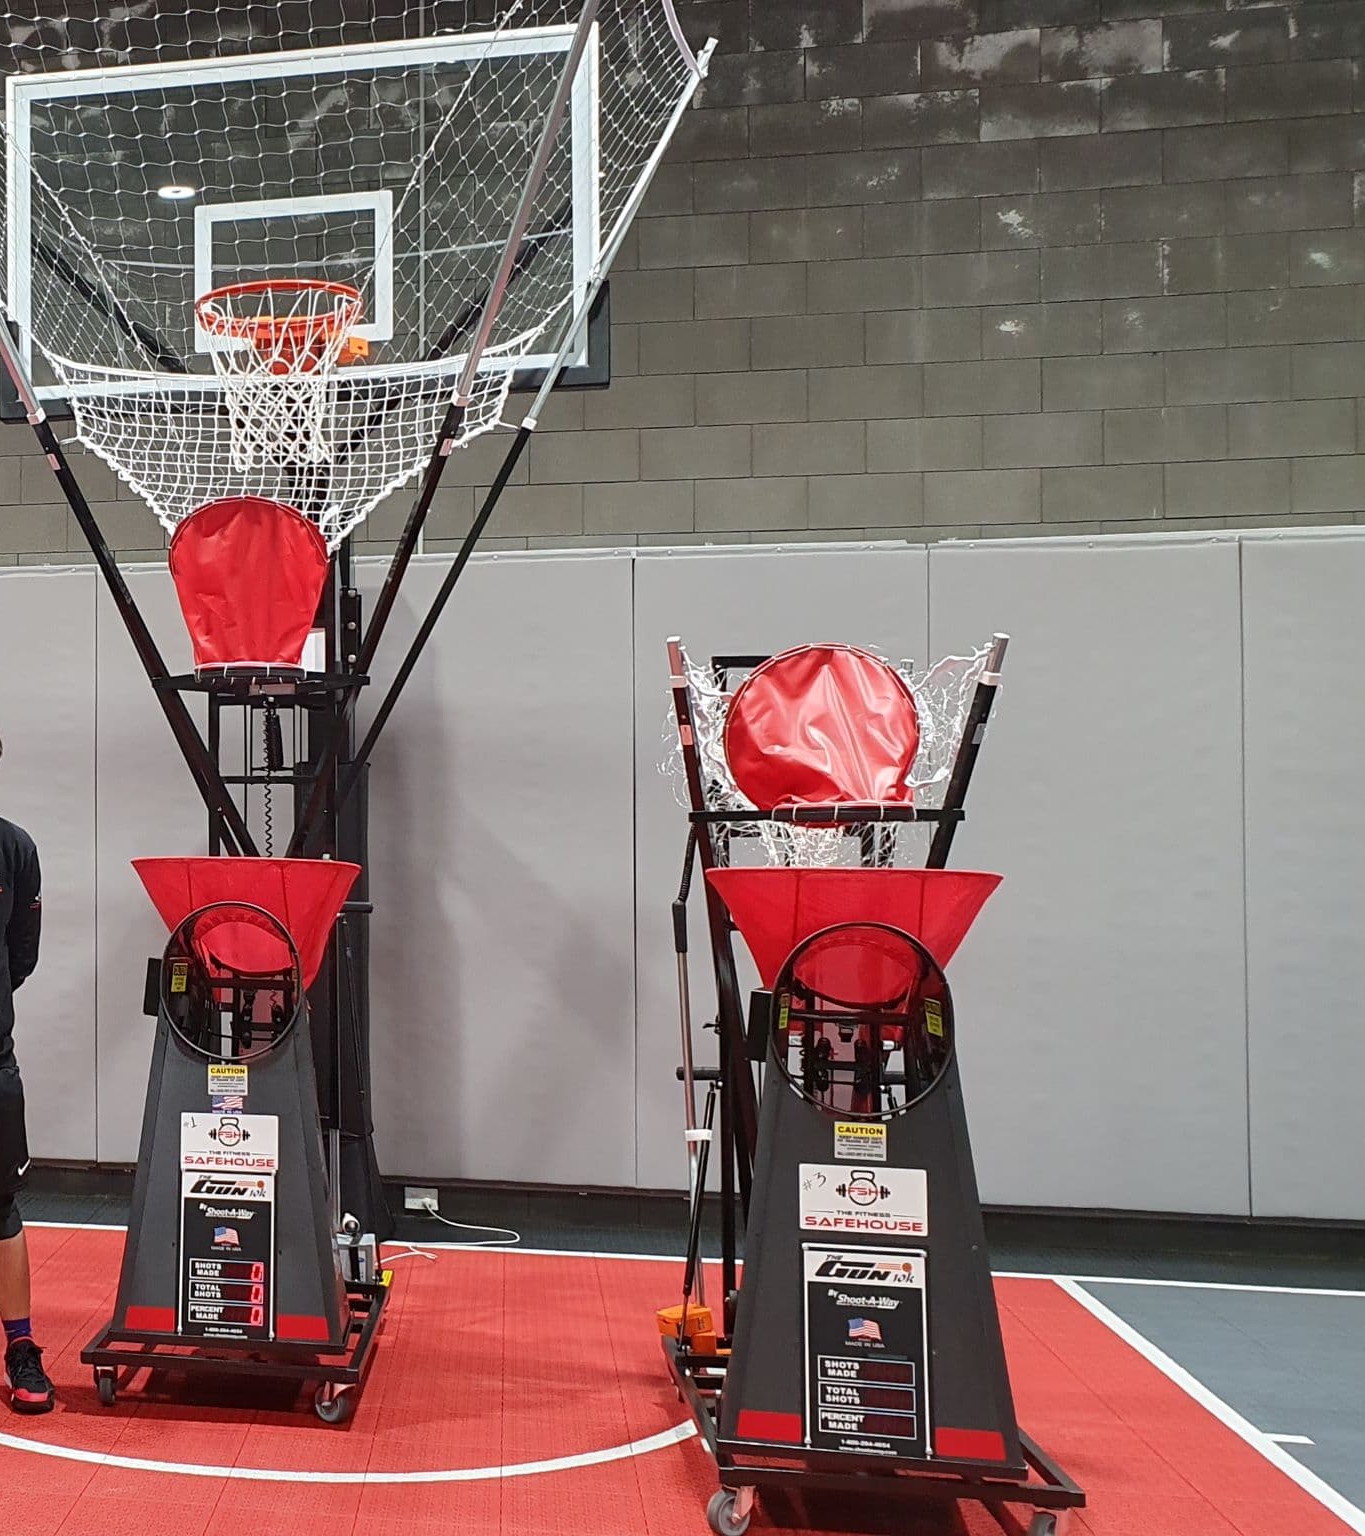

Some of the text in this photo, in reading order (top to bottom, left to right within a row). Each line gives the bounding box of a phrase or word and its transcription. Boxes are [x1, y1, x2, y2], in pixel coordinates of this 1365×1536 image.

[837, 1126, 883, 1135] CAUTION
[184, 1156, 275, 1167] SAFEHOUSE
[802, 1172, 827, 1191] #3
[805, 1216, 923, 1232] SAFEHOUSE
[195, 1262, 222, 1270] SHOTS
[190, 1305, 224, 1313] PERCENT
[824, 1360, 860, 1370] SHOTS
[828, 1369, 857, 1378] MADE
[826, 1386, 859, 1396] TOTAL
[825, 1395, 860, 1404] SHOTS
[822, 1412, 865, 1423] PERCENT
[828, 1421, 858, 1431] MADE
